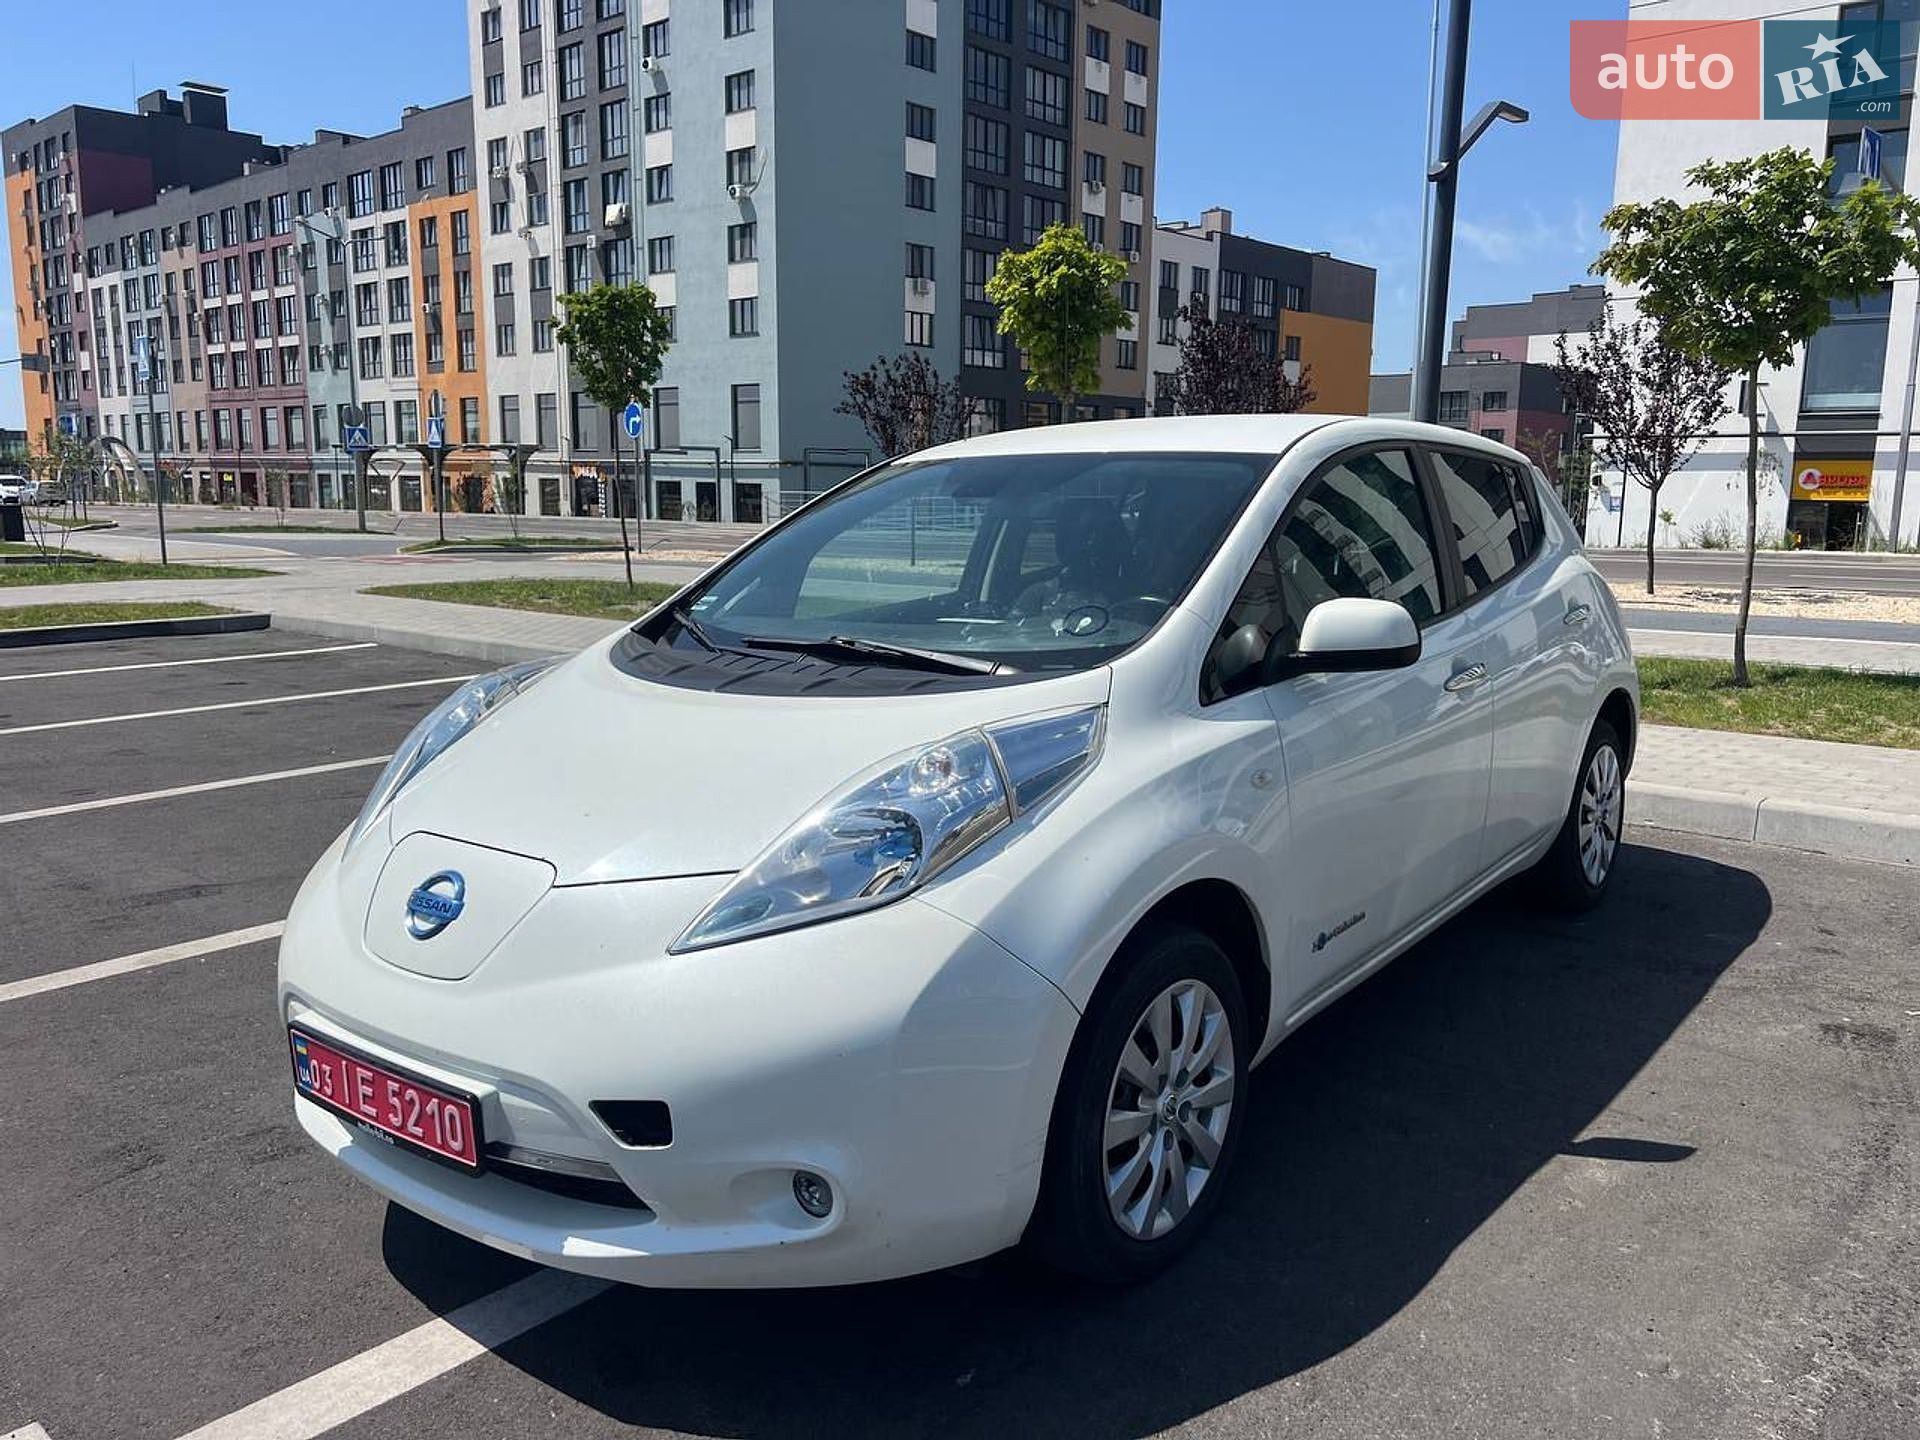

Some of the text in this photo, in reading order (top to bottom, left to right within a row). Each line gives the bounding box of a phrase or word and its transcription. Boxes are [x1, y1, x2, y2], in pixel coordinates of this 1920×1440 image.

[310, 1059, 333, 1096] 03
[341, 1060, 377, 1118] IE
[386, 1079, 464, 1152] 5210
